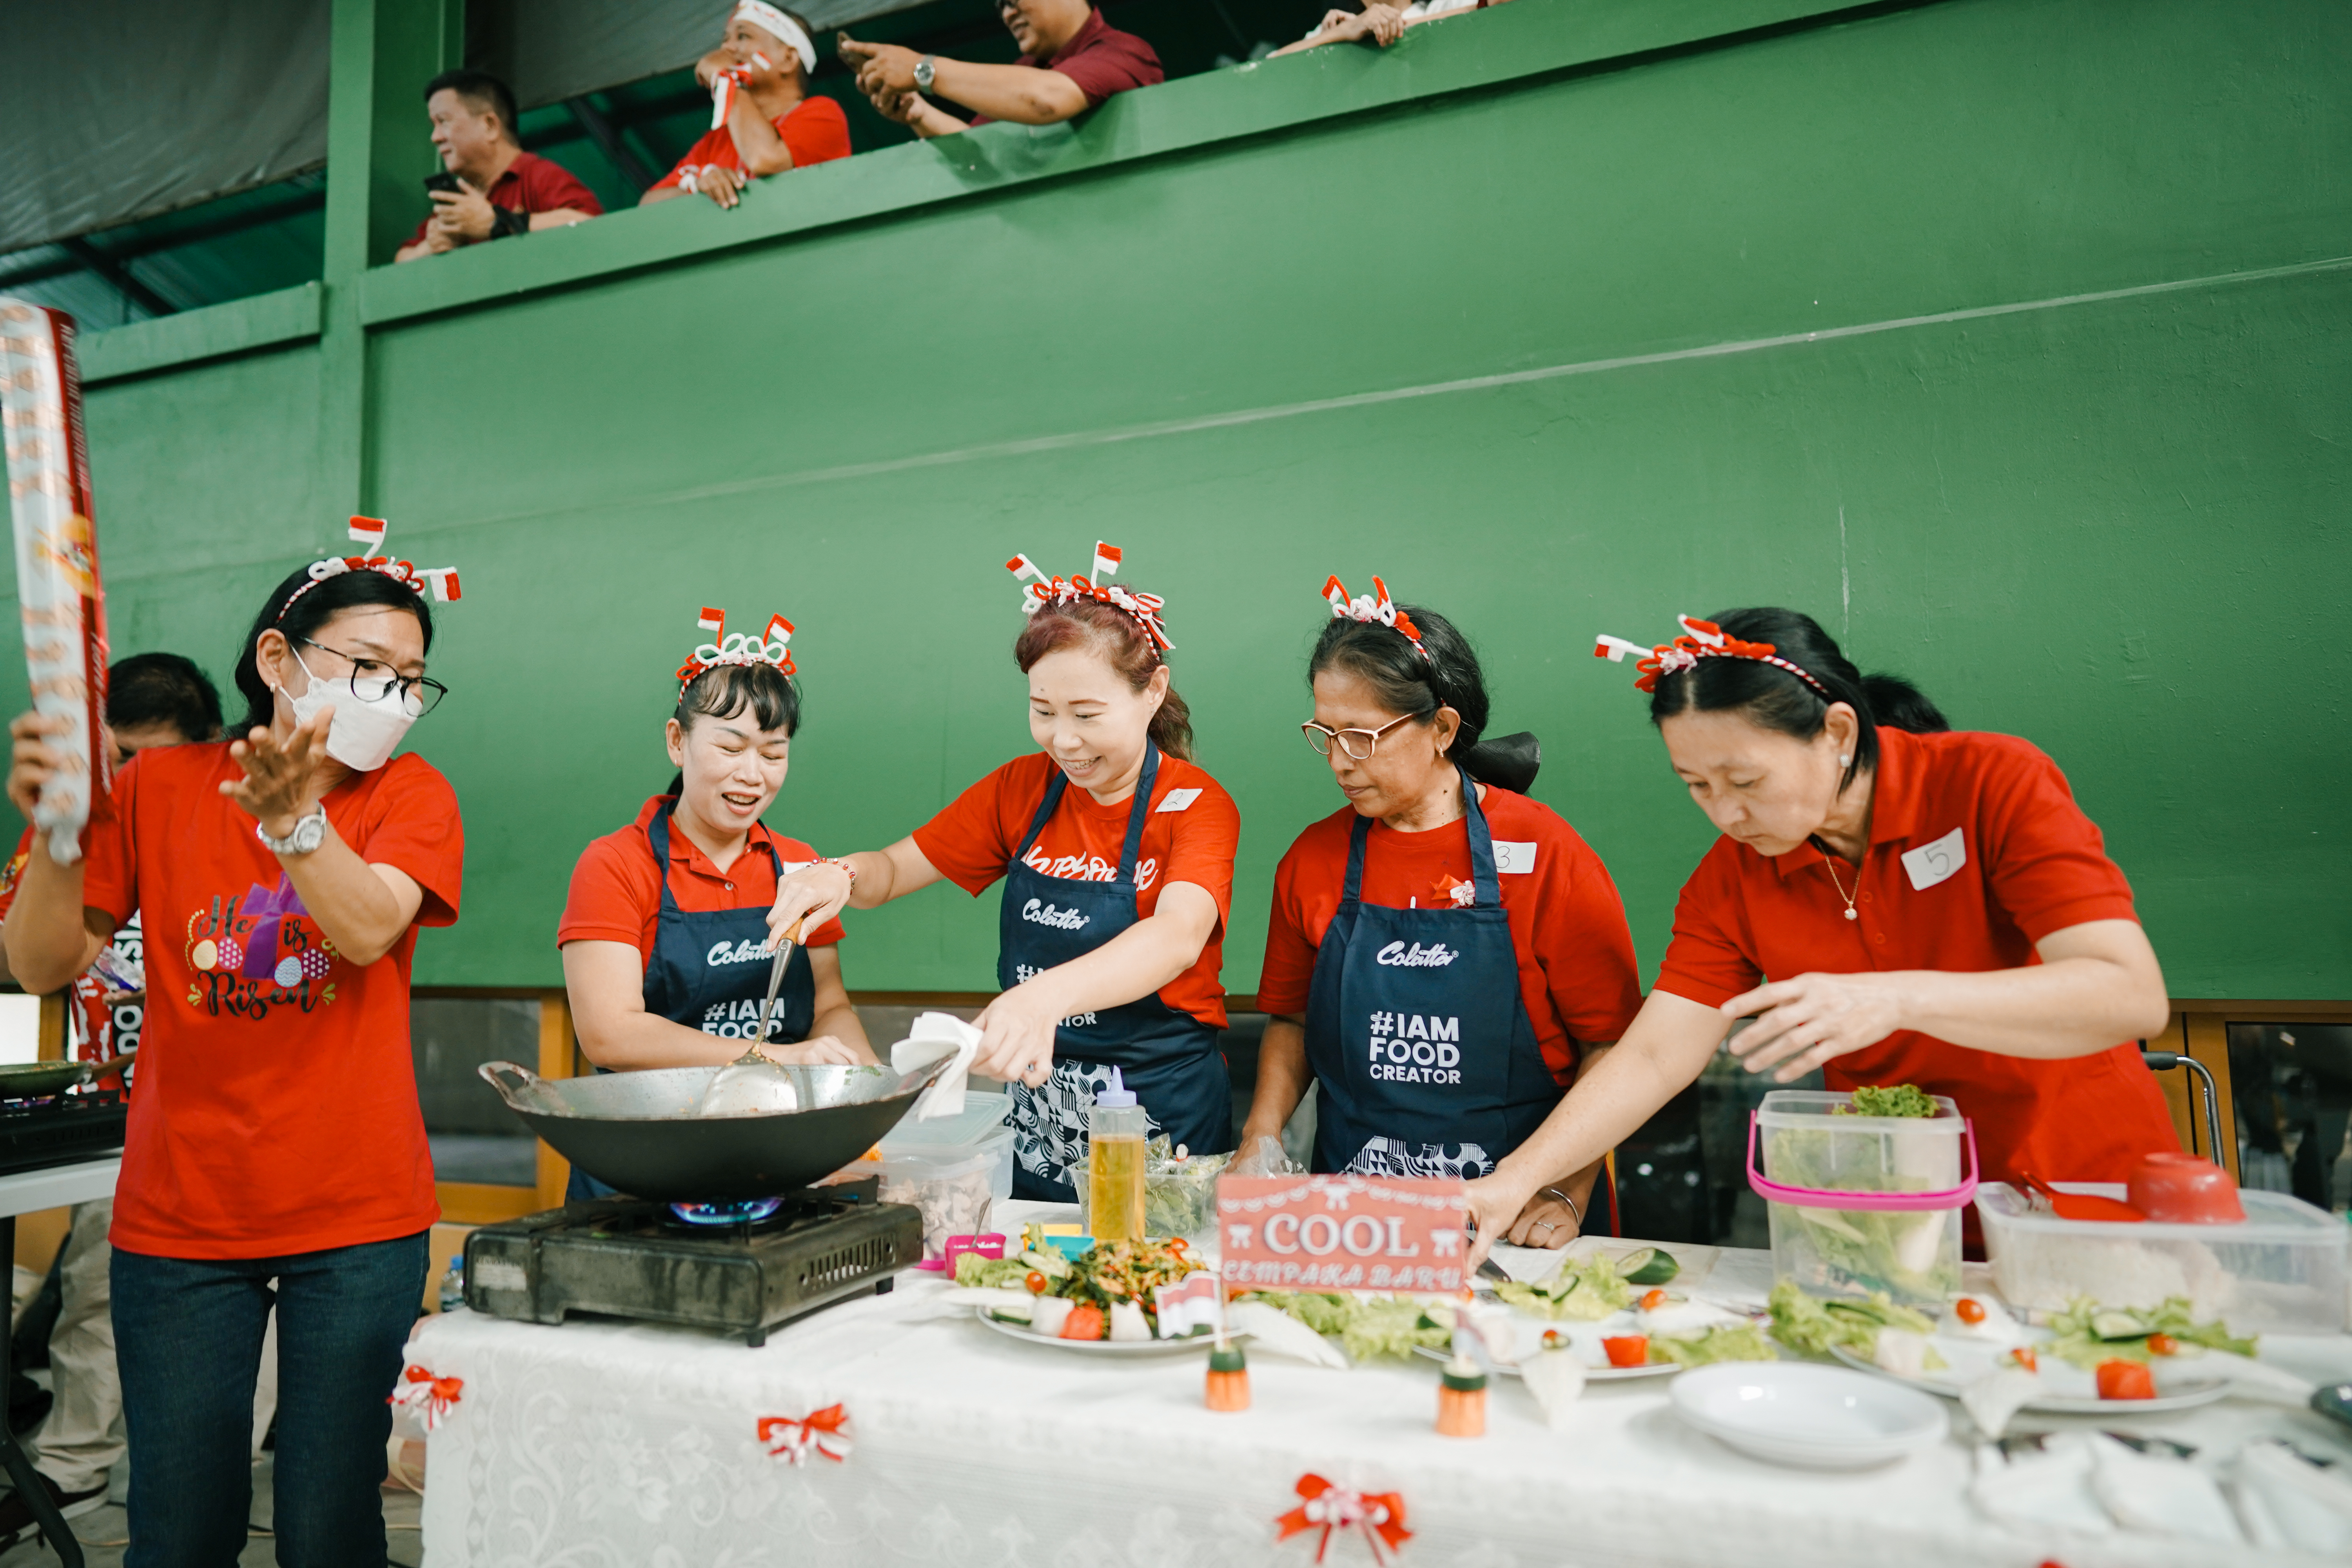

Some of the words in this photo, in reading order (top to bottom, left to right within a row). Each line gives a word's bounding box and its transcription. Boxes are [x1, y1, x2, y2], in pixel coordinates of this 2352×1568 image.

[1167, 792, 1183, 806] 2
[1495, 846, 1510, 868] 3
[1924, 843, 1950, 876] 5
[197, 895, 254, 937] He
[284, 919, 312, 953] is
[197, 970, 318, 1020] Risen
[704, 997, 785, 1021] #IAM
[1370, 1010, 1459, 1042] #IAM
[1369, 1036, 1461, 1068] FOOD
[1369, 1063, 1461, 1084] CREATOR
[1263, 1213, 1421, 1258] COOL
[1221, 1259, 1364, 1287] CEMPAKA
[1368, 1264, 1463, 1290] BARU
